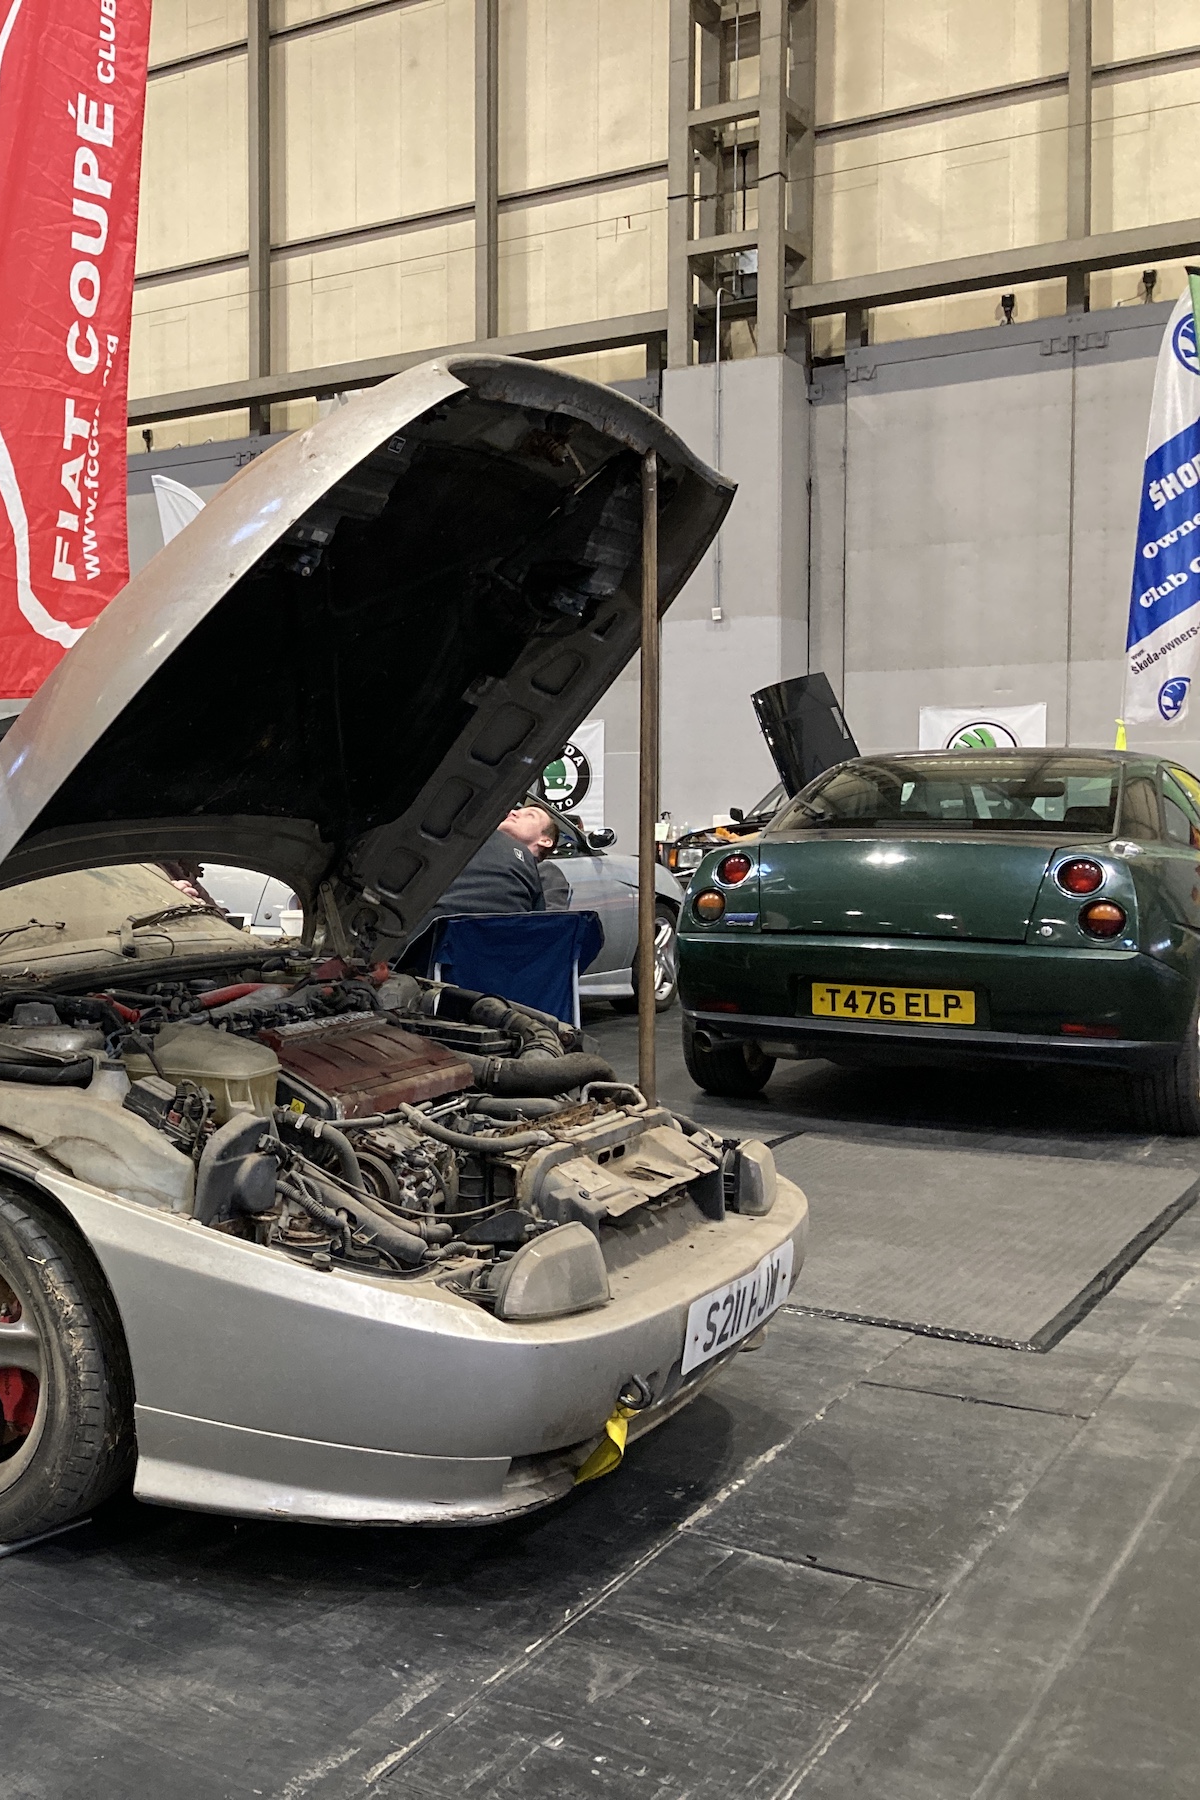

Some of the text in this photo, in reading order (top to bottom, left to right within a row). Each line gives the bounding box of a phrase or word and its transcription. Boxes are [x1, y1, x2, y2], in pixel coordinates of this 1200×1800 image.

[66, 92, 115, 375] COUPÉ
[51, 398, 91, 582] FIAT
[1139, 570, 1189, 609] Club
[825, 988, 961, 1018] T476 ELP
[702, 1286, 747, 1353] S211
